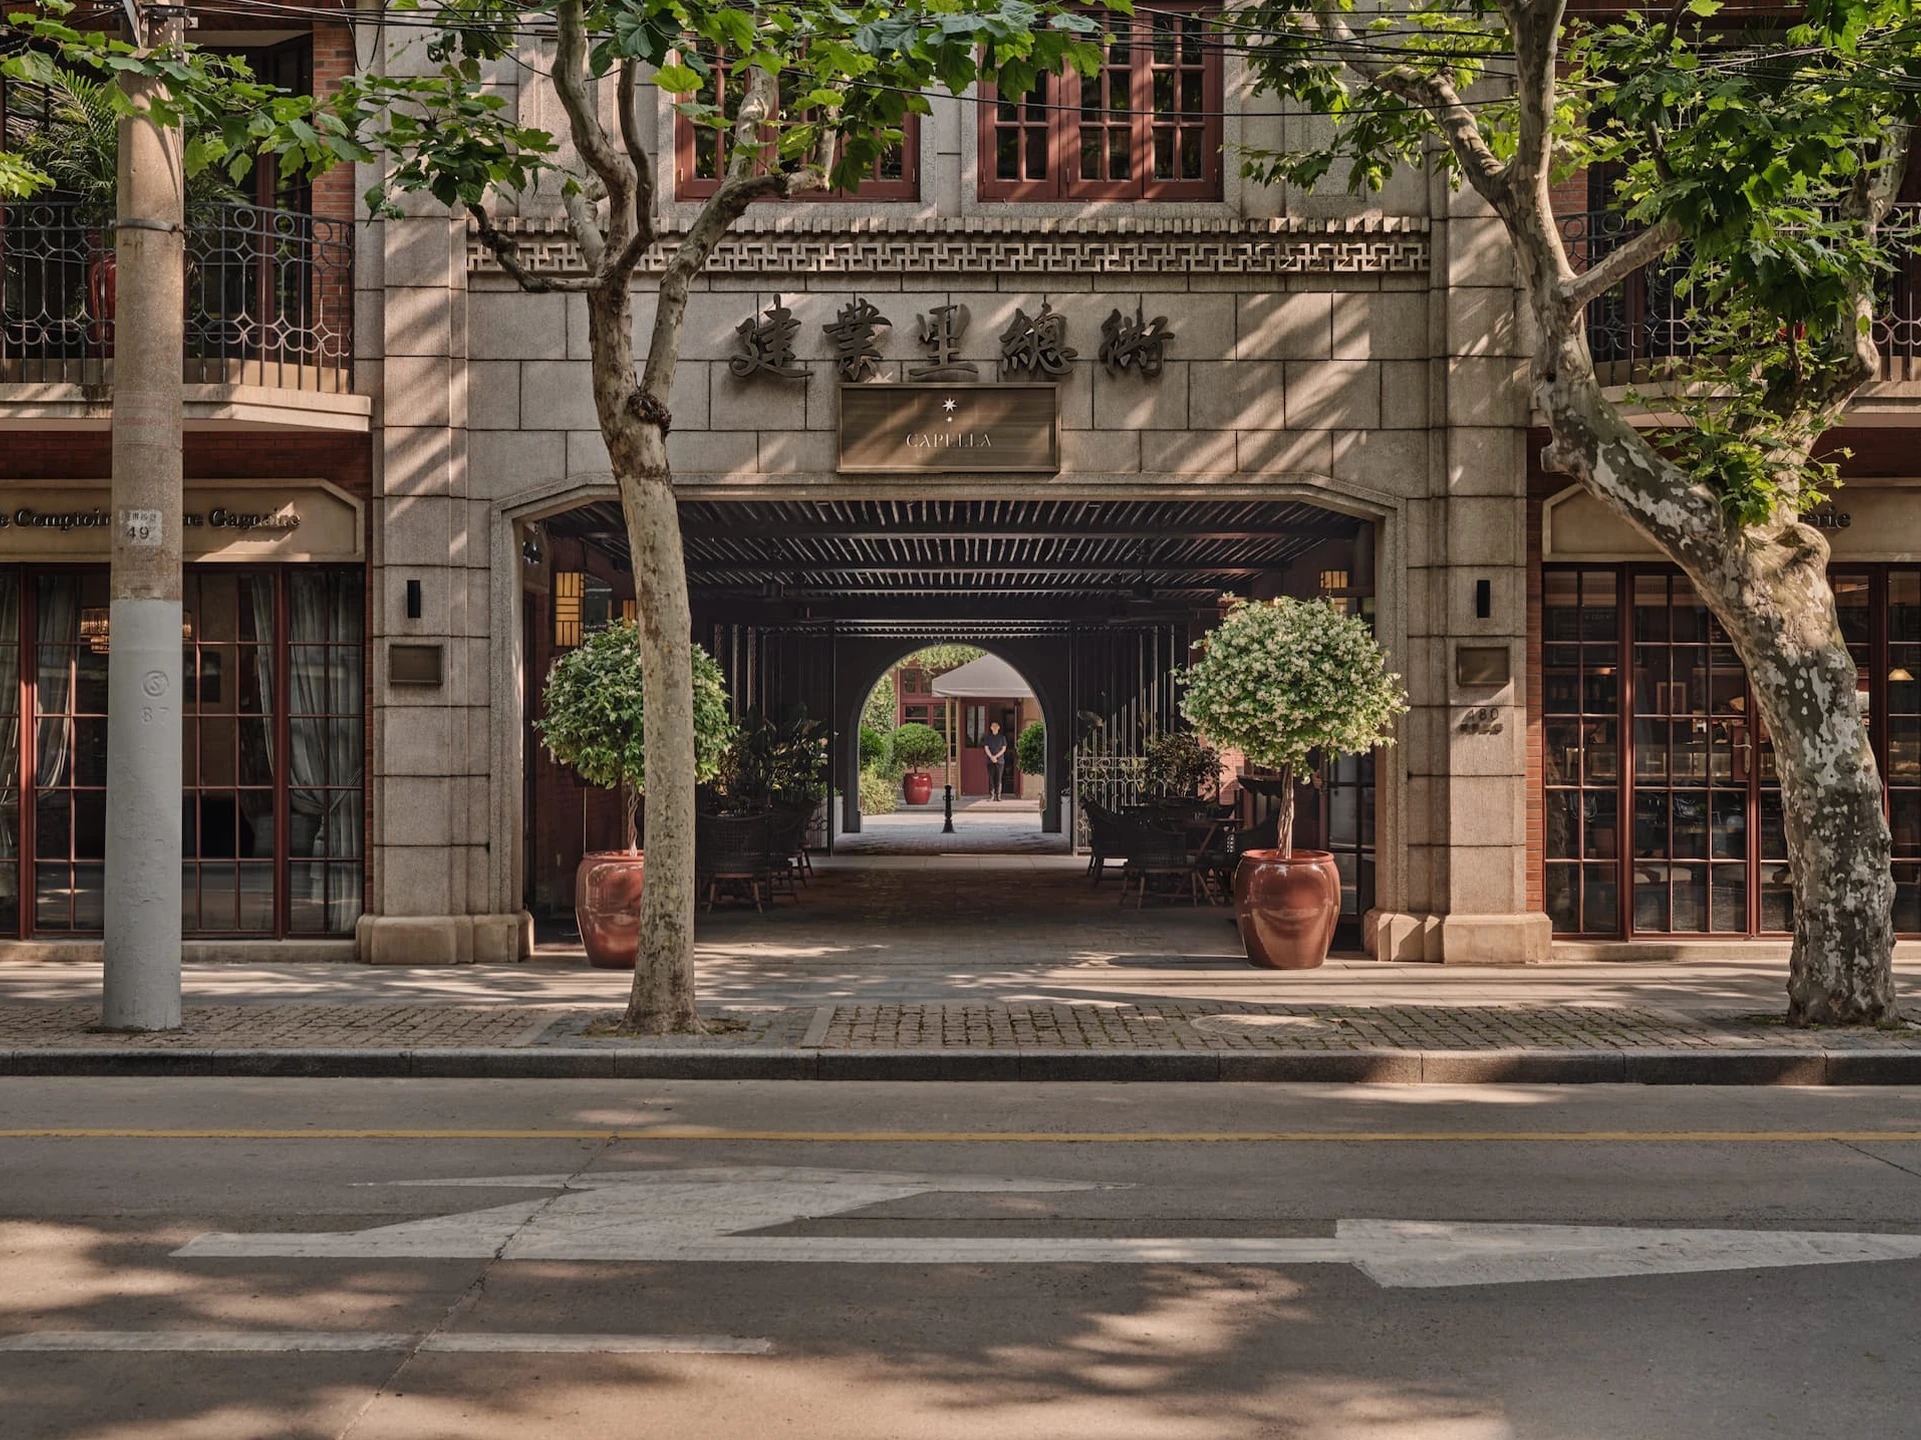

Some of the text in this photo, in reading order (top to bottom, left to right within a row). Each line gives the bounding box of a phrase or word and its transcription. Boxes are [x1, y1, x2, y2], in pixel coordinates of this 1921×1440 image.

[906, 433, 991, 448] CAPELLA
[209, 507, 300, 530] Gagnaire
[125, 526, 149, 539] 49
